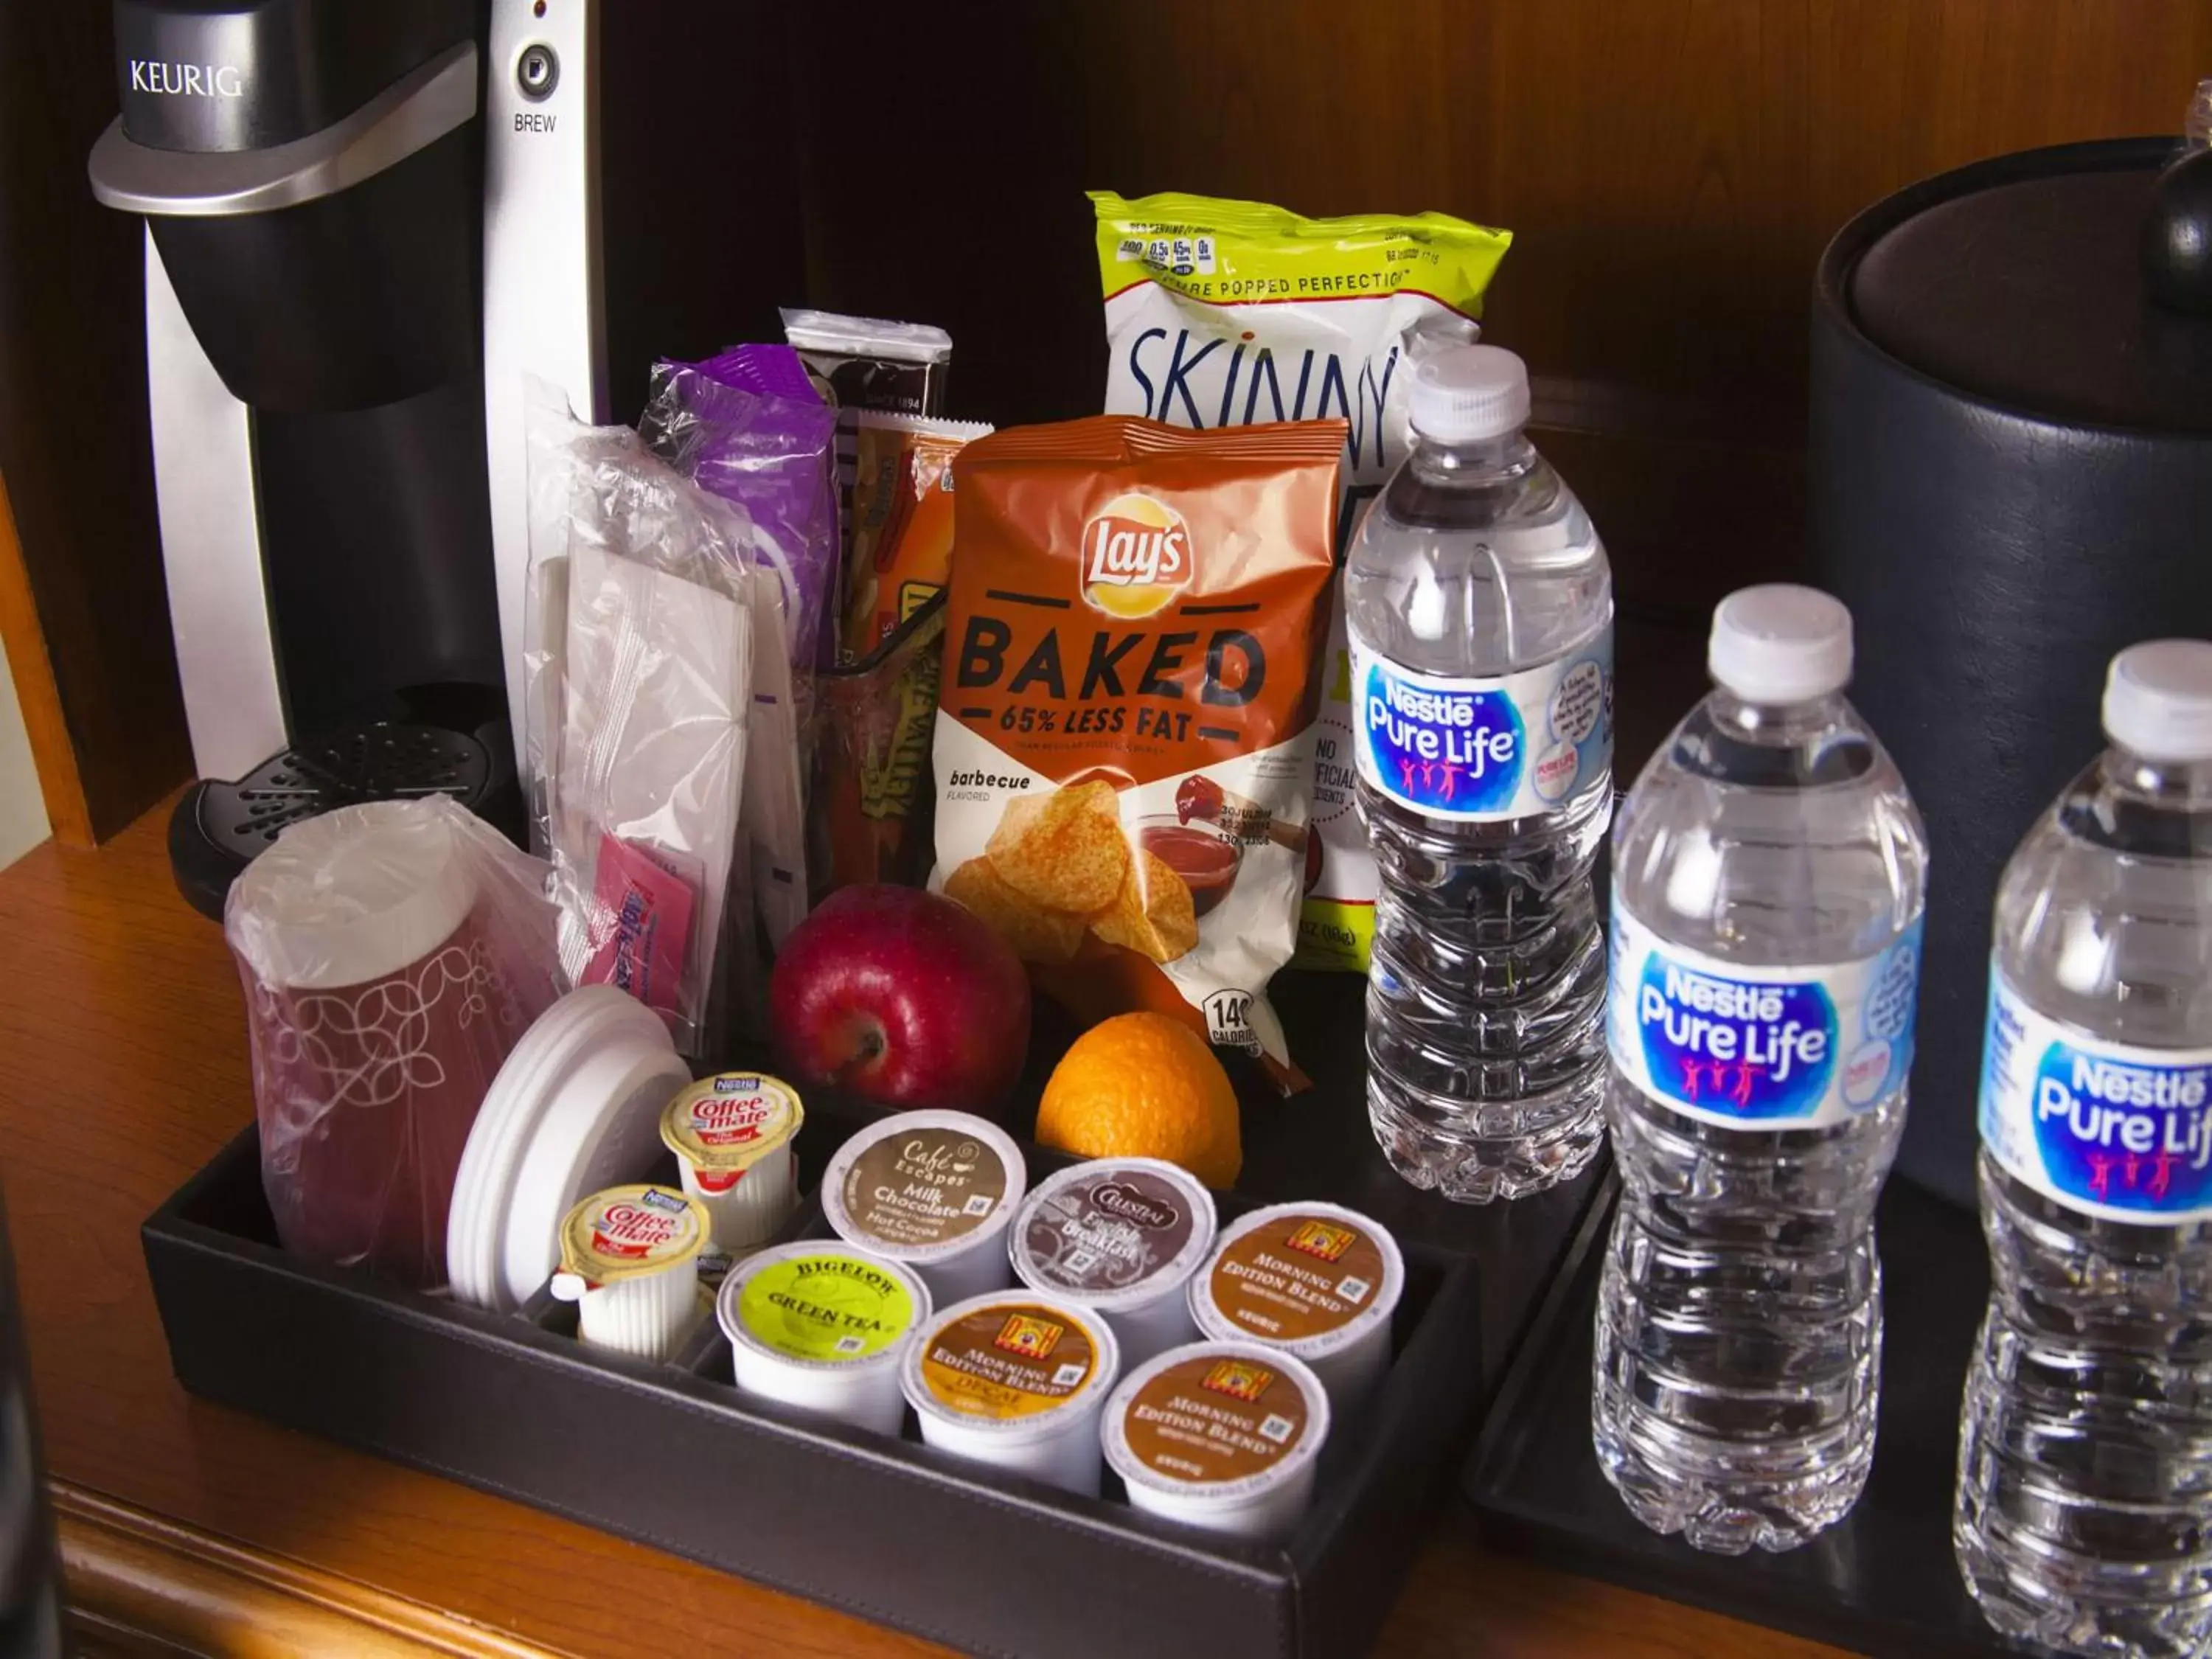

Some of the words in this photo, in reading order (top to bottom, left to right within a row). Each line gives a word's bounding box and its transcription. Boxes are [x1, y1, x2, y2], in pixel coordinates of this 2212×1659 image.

[131, 60, 243, 97] KEURIG
[515, 114, 557, 132] BREW
[1221, 279, 1290, 295] POPPED
[1130, 327, 1399, 472] SKINNY
[1088, 518, 1183, 585] Lay's
[957, 615, 1266, 707] BAKED
[1385, 678, 1474, 727] Nestlé
[1000, 706, 1055, 733] 65%
[1064, 707, 1126, 734] LESS
[1135, 707, 1192, 742] FAT
[1370, 696, 1439, 759] Pure
[1445, 726, 1514, 779] Life
[1315, 737, 1336, 759] NO
[946, 791, 991, 802] FLAVORED
[949, 769, 1031, 790] barbecue
[1666, 964, 1784, 1021] Nestlé
[1642, 984, 1737, 1061] Pure
[1745, 1020, 1826, 1082] Life
[2071, 1054, 2207, 1109] Nestlé
[693, 1096, 763, 1120] Coffee
[709, 1110, 768, 1129] mate
[2038, 1077, 2156, 1153] Pure
[894, 1159, 964, 1187] Escapes
[904, 1141, 953, 1171] Café
[874, 1186, 961, 1219] Chocolate
[903, 1183, 944, 1203] Milk
[1099, 1189, 1165, 1225] CELESTIAL
[605, 1205, 675, 1229] Coffee
[611, 1224, 670, 1244] mate
[866, 1212, 893, 1228] Hot
[895, 1220, 939, 1237] Cocoa
[1221, 1260, 1287, 1290] EDITION
[1287, 1281, 1343, 1312] BLEND
[1253, 1252, 1332, 1290] MORNING
[768, 1292, 839, 1323] GREEN
[843, 1313, 881, 1332] TEA
[932, 1347, 1003, 1384] EDITION
[1004, 1374, 1062, 1396] BLEND
[964, 1347, 1048, 1382] MORNING
[1133, 1403, 1206, 1433] EDITION
[1208, 1422, 1267, 1455] BLEND
[1167, 1396, 1255, 1432] MORNING
